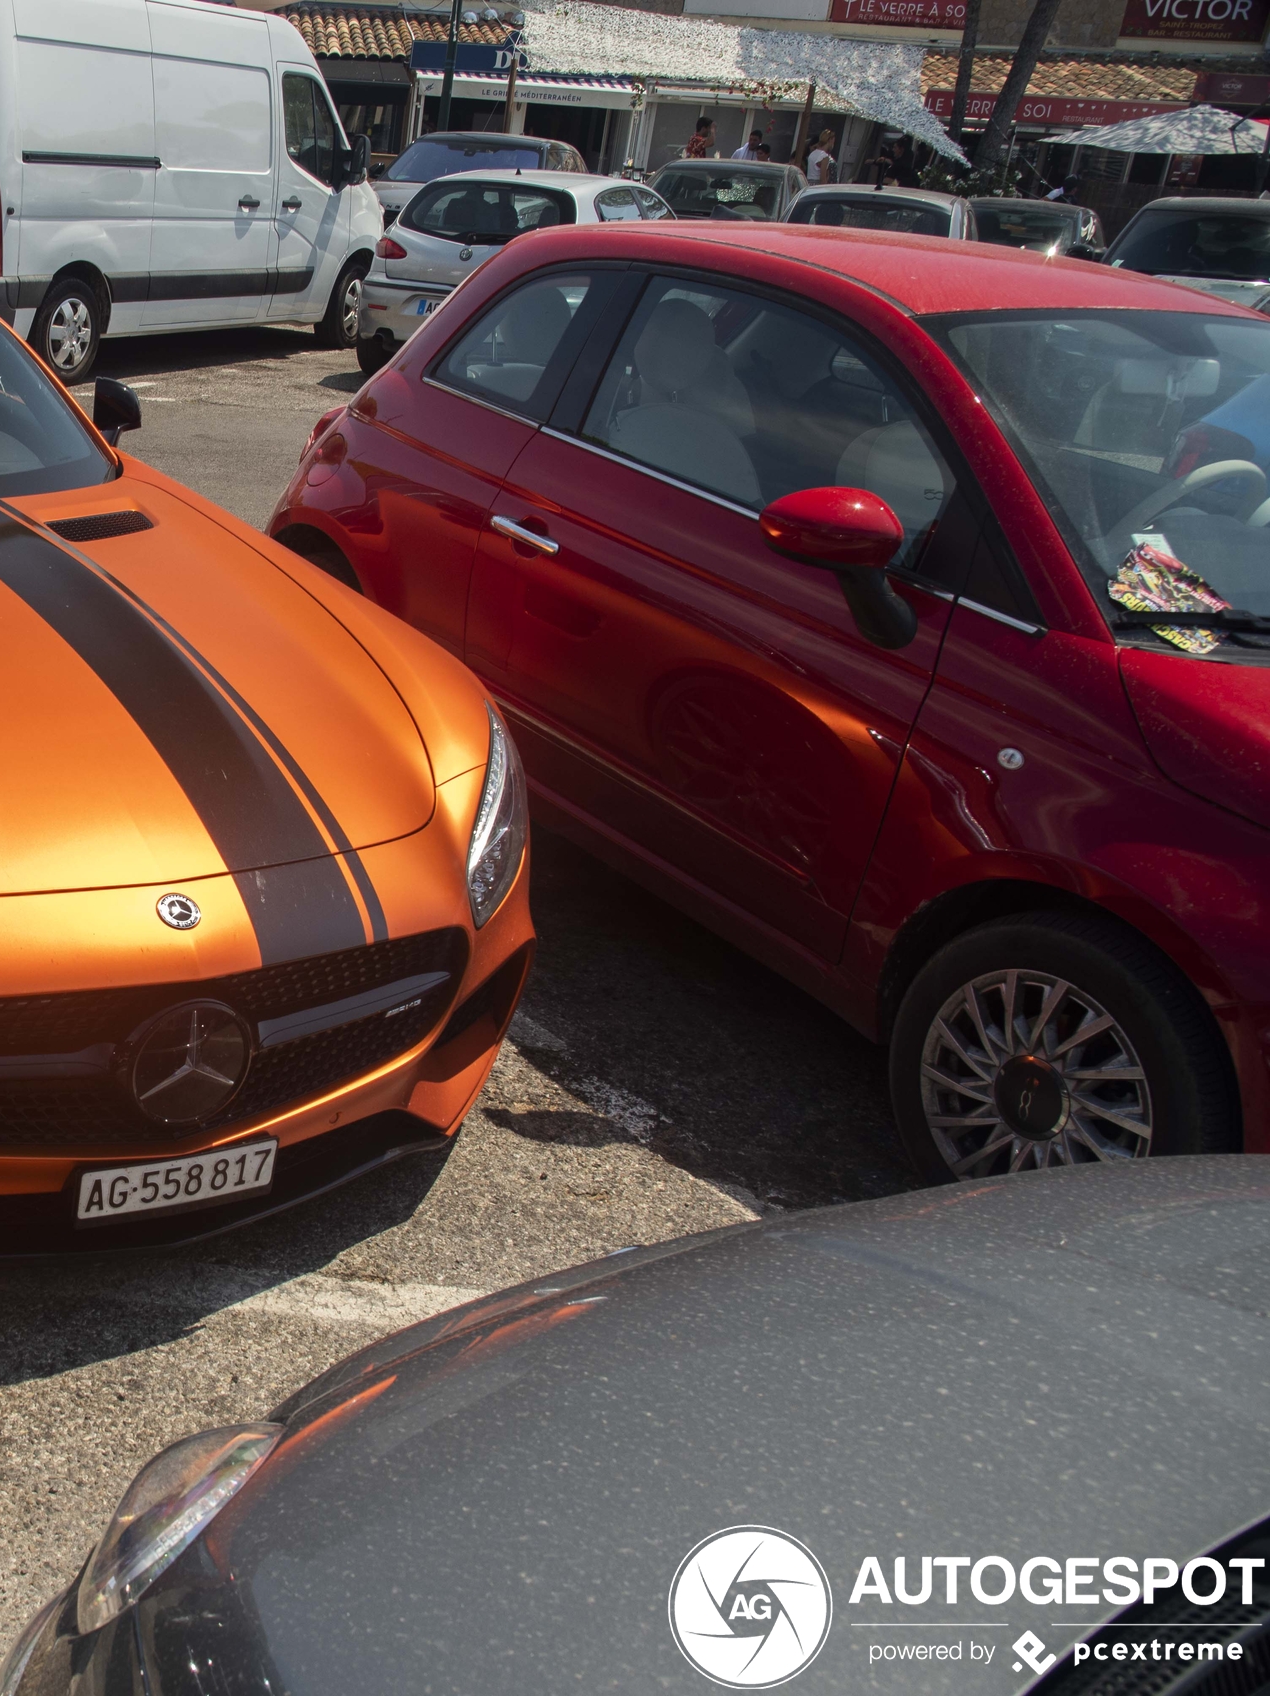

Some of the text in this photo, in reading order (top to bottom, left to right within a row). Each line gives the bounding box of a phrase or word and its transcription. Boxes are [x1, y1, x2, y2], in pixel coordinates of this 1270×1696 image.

[860, 0, 966, 18] LE VERRE À SO
[1145, 0, 1252, 20] VICTOR
[858, 13, 913, 23] RESTAURANT
[1159, 21, 1225, 30] SAINT-TROPEZ
[1173, 30, 1232, 39] RESTAURANT
[520, 90, 582, 102] MÉDITERRANÉEN
[927, 98, 945, 112] LE
[1023, 103, 1052, 118] SOI
[1062, 115, 1105, 124] RESTAURANT
[211, 1148, 272, 1191] 817
